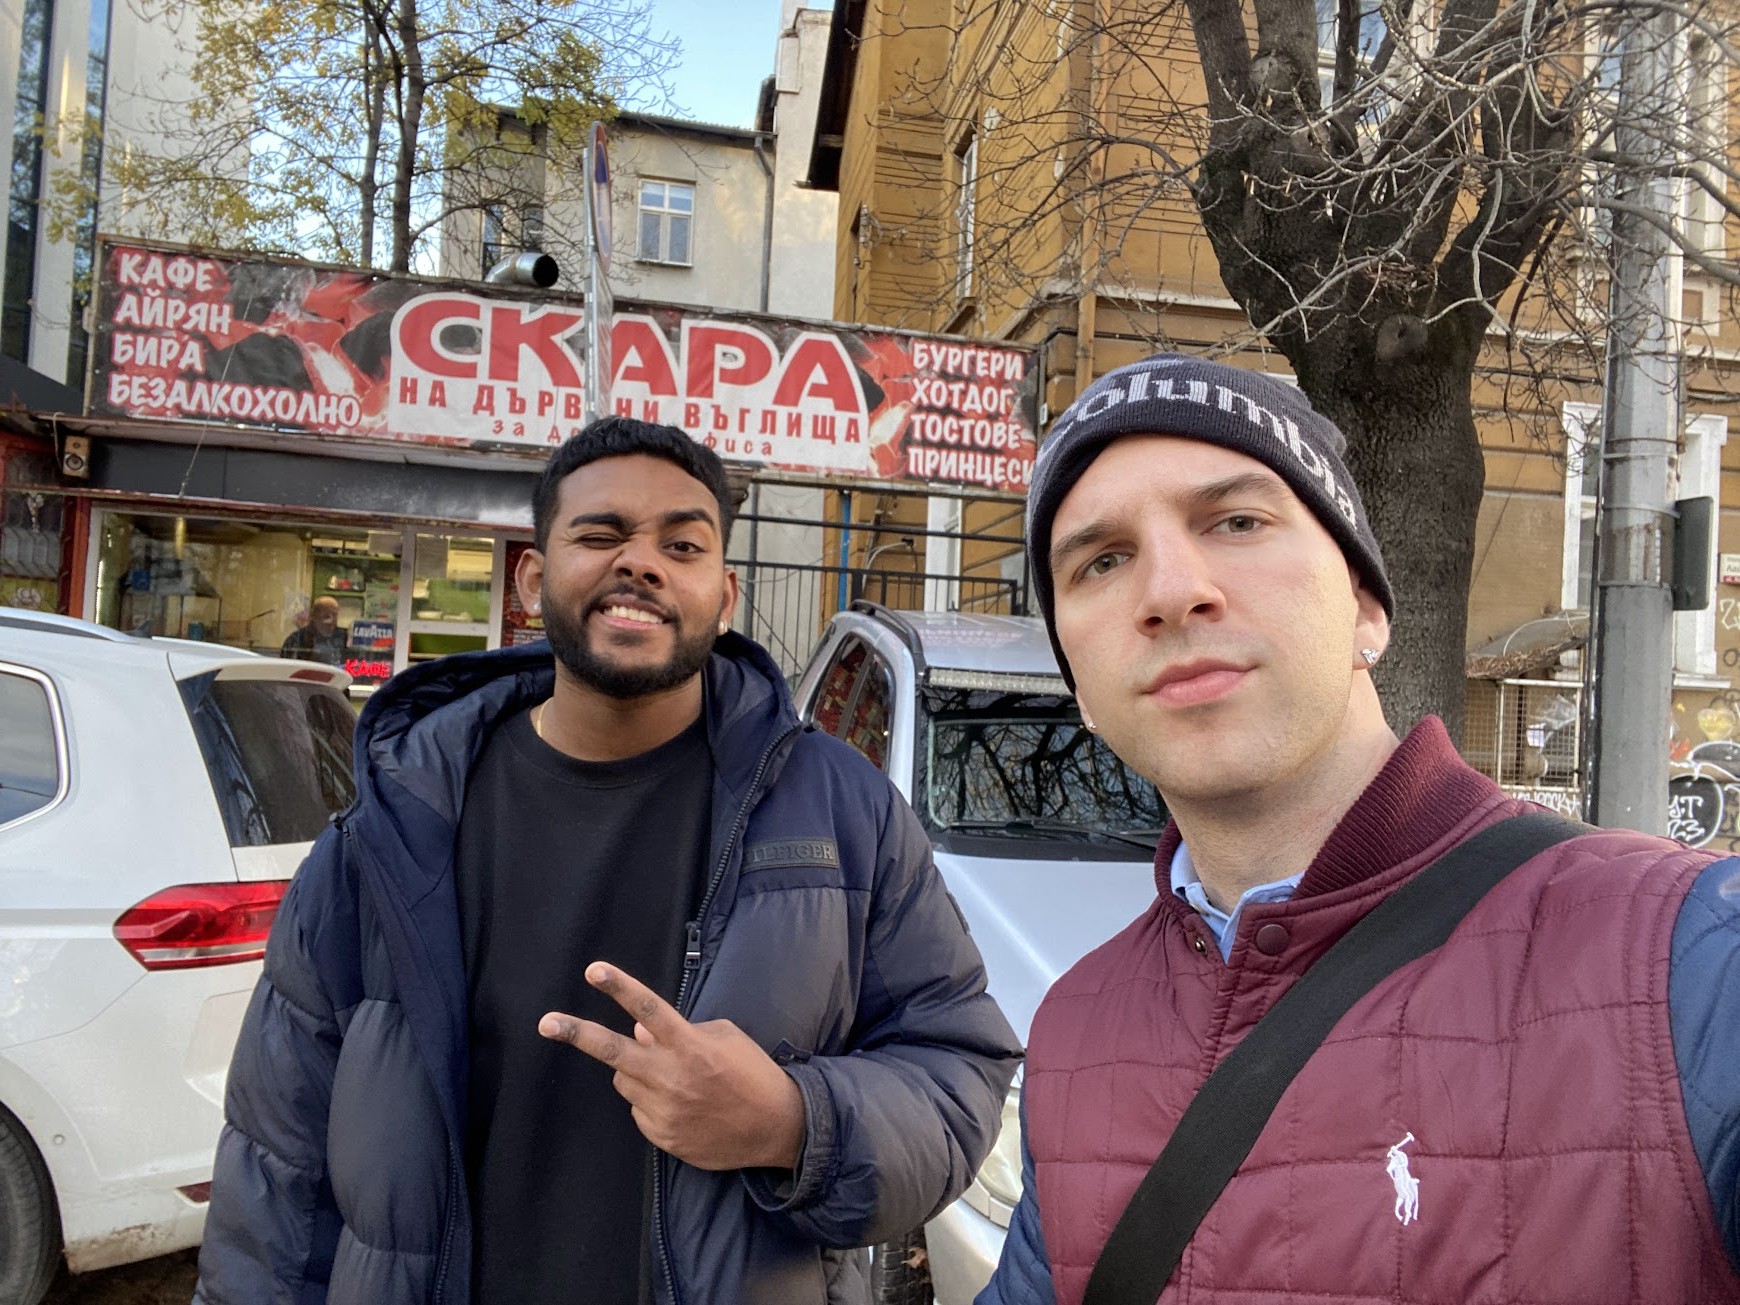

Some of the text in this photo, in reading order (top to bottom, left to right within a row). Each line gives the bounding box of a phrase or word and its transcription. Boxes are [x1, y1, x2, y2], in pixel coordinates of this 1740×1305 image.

[119, 253, 214, 290] КАФЕ
[115, 290, 231, 334] АЙРЯН
[112, 333, 203, 372] БИРА
[399, 298, 860, 414] СКАРА
[912, 342, 1024, 381] БУРГЕРИ
[109, 372, 361, 426] БЕЗАЛКОХОЛНО
[399, 376, 860, 445] НА ДЪРВНИ ВЪГЛИЩА
[911, 377, 1013, 416] ХОТДОГ
[492, 419, 525, 437] за
[910, 413, 1020, 450] ТОСТОВЕ
